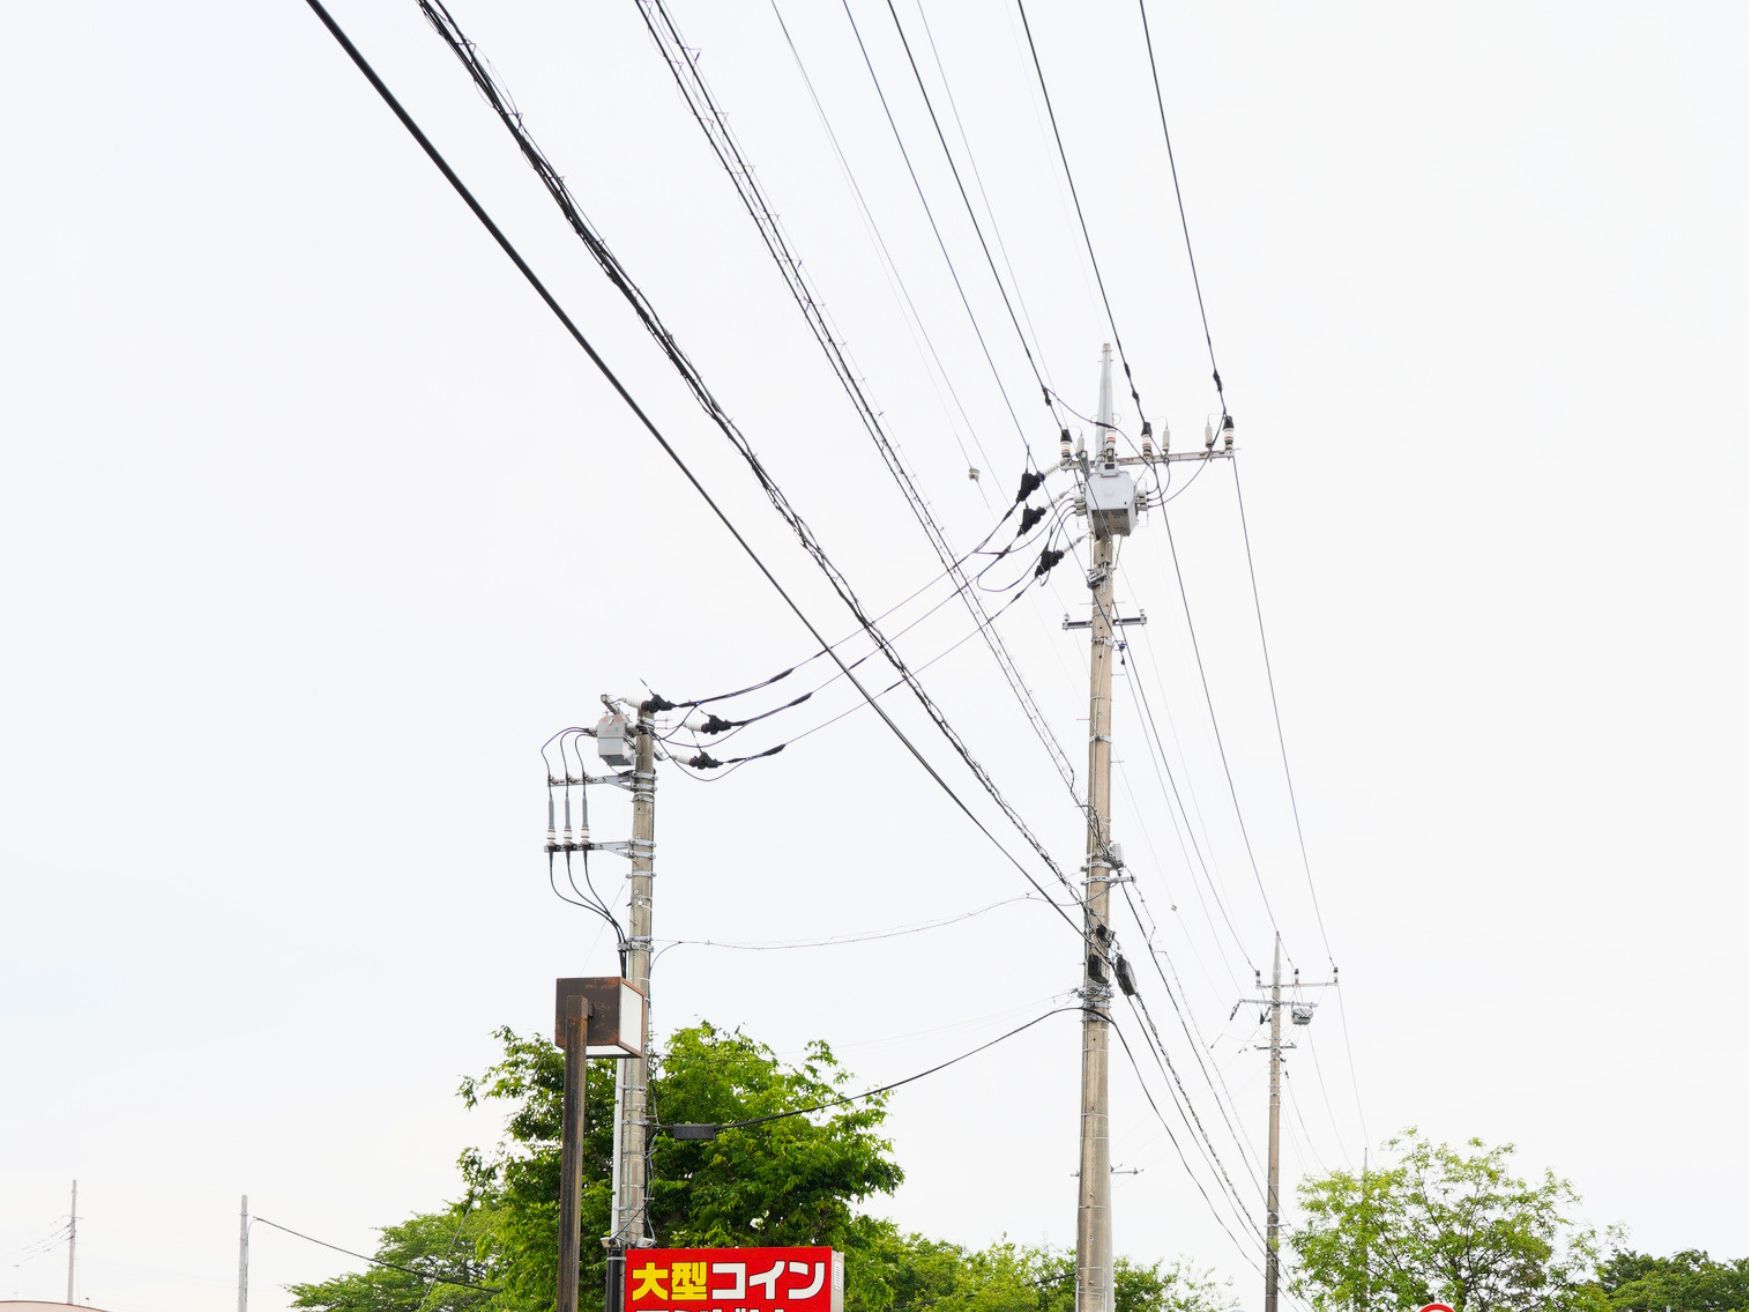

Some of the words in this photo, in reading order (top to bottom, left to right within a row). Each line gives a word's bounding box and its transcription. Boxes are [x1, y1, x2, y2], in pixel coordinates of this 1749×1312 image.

[632, 1261, 826, 1301] 大型コイン
